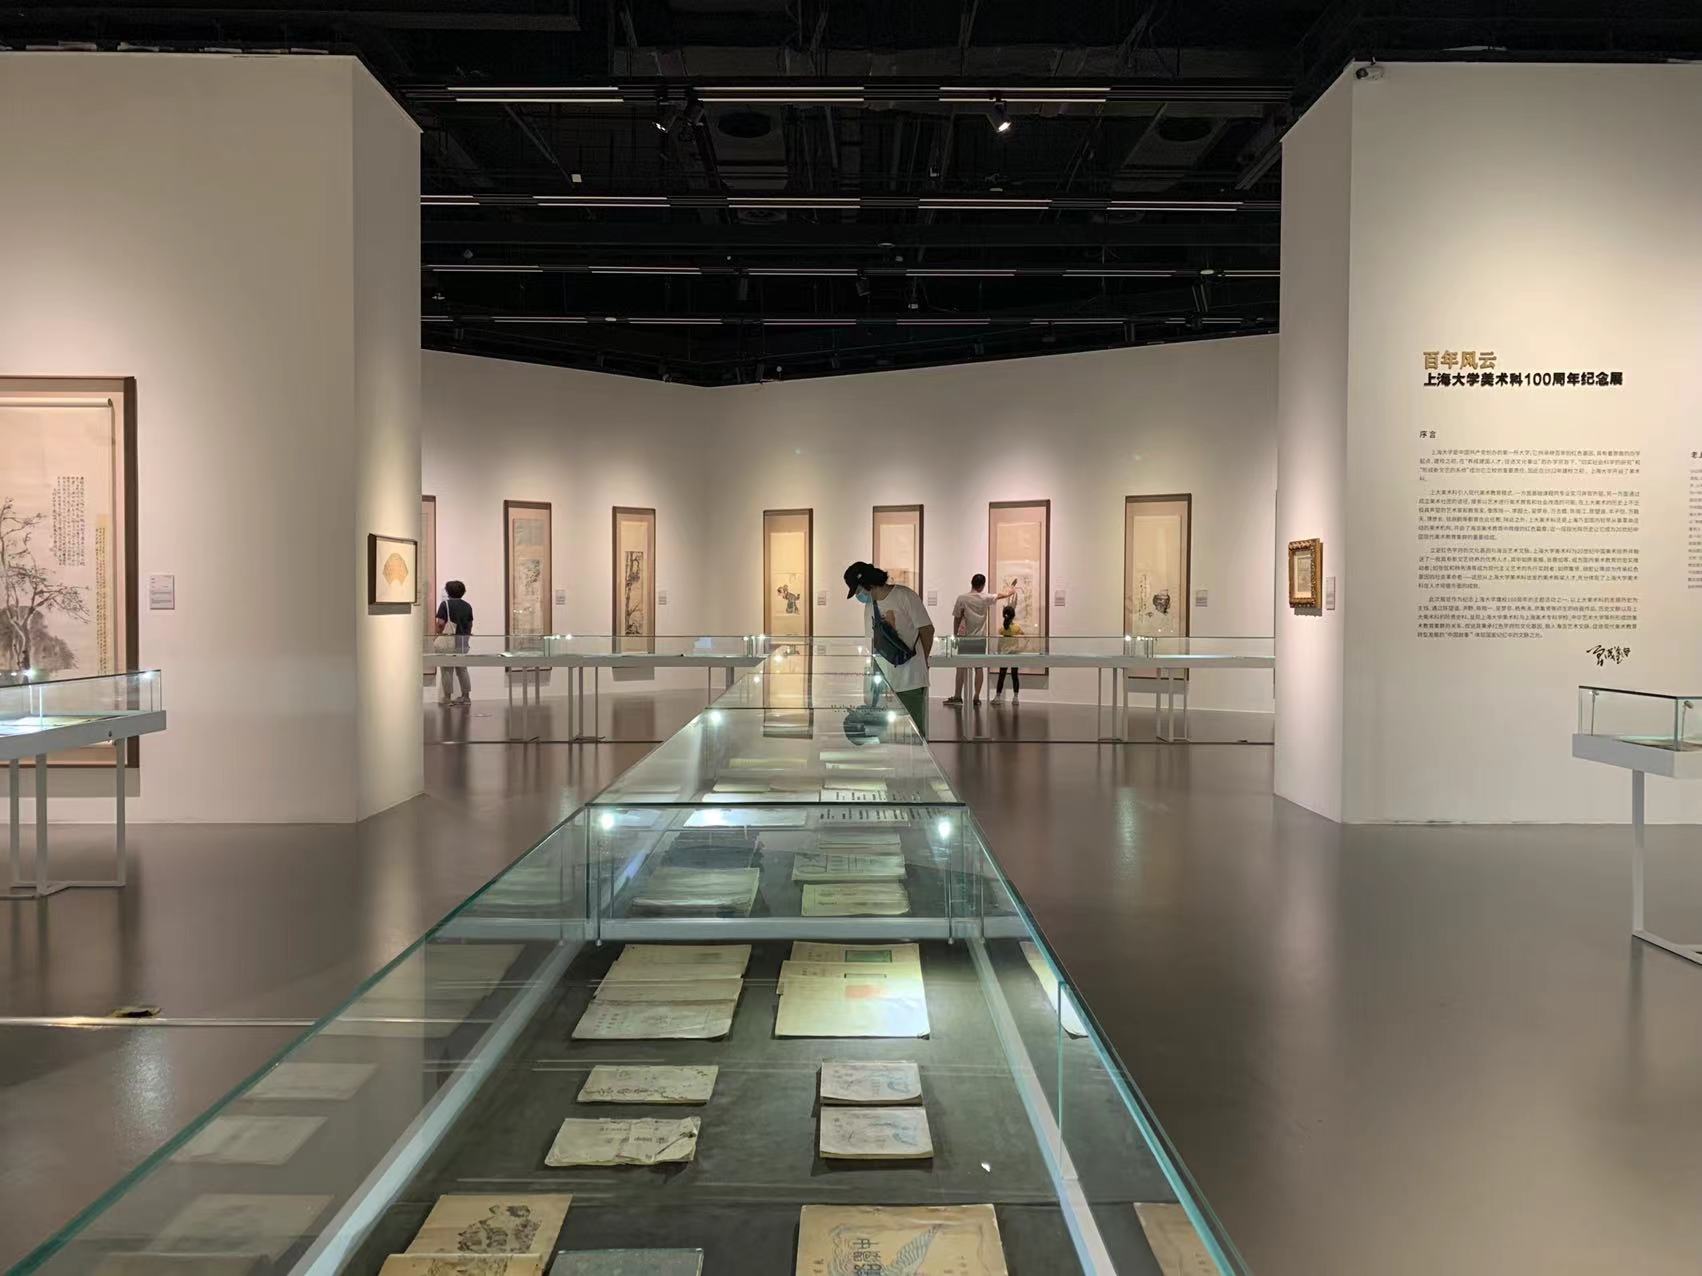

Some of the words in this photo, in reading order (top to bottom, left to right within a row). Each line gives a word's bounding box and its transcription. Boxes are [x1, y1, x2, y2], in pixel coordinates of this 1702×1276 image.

[1423, 350, 1497, 369] 百年风云
[1423, 371, 1624, 387] 上海大学美术科100周年纪念展
